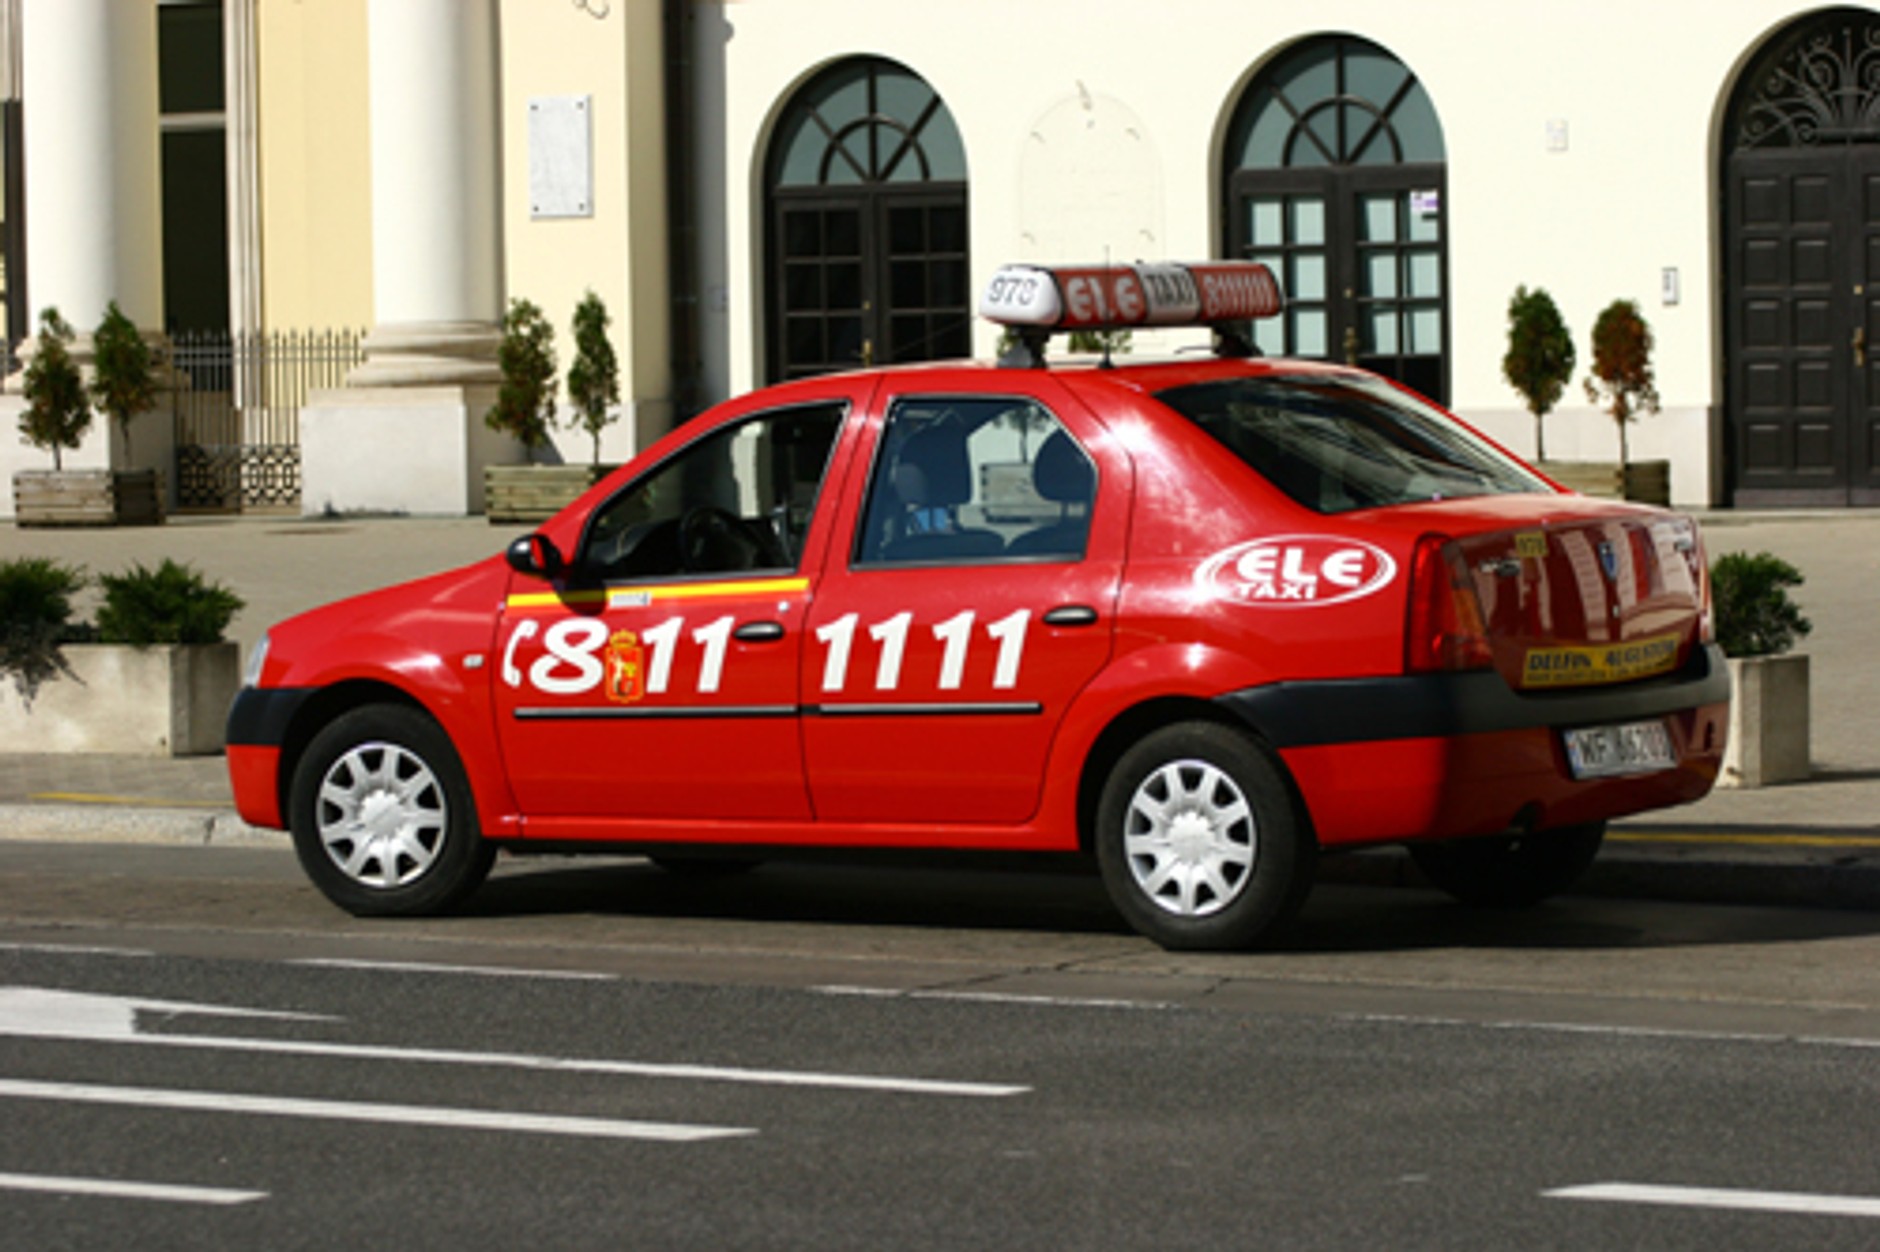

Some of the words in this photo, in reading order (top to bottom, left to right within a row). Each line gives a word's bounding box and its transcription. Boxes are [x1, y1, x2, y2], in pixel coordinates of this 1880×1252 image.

[1066, 275, 1139, 321] ELE
[1144, 273, 1197, 306] TAXI
[1236, 547, 1366, 587] ELE
[1236, 582, 1316, 599] TAXI
